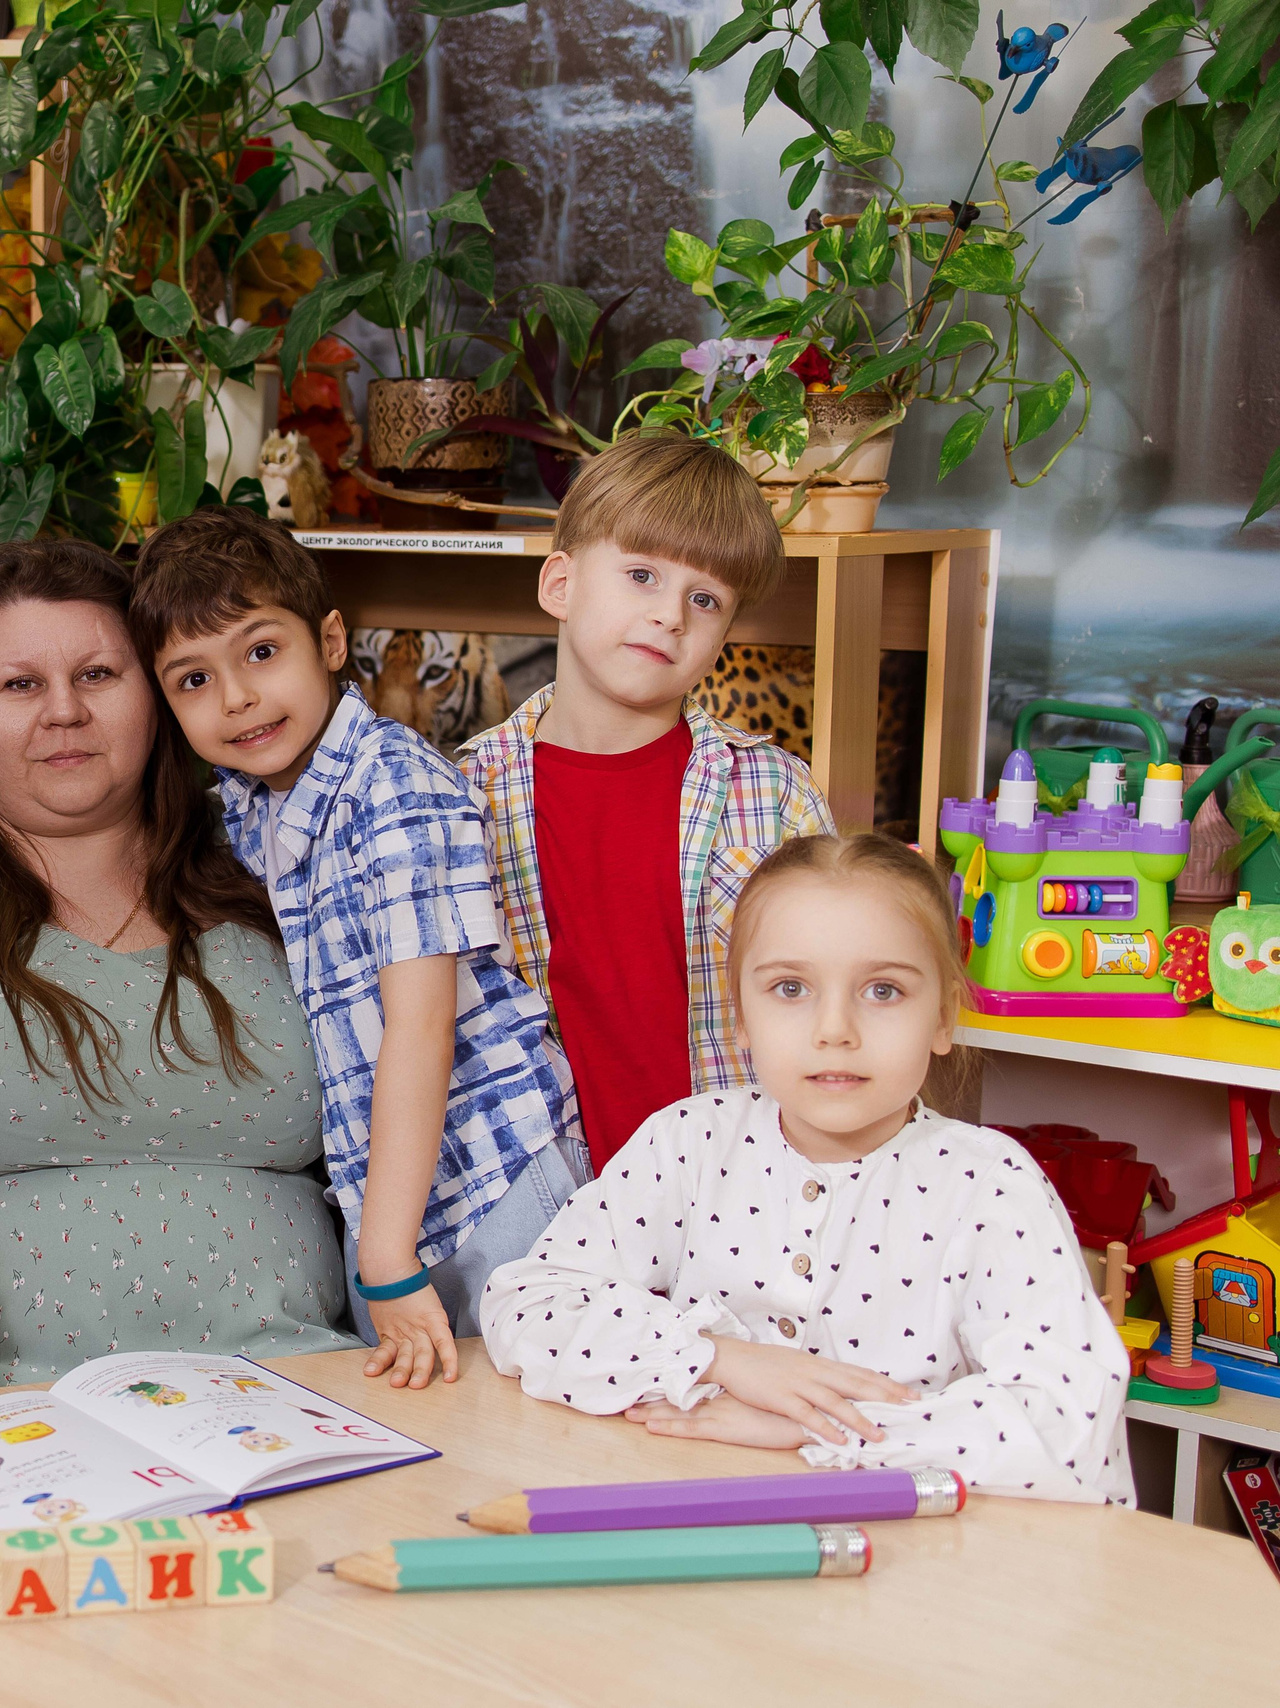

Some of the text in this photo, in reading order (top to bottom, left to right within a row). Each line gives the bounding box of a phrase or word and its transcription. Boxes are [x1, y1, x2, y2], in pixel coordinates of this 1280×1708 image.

[302, 536, 504, 550] ЦЕНТР ЭКОЛОГИЧЕСКОГО ВОСПИТАНИЯ
